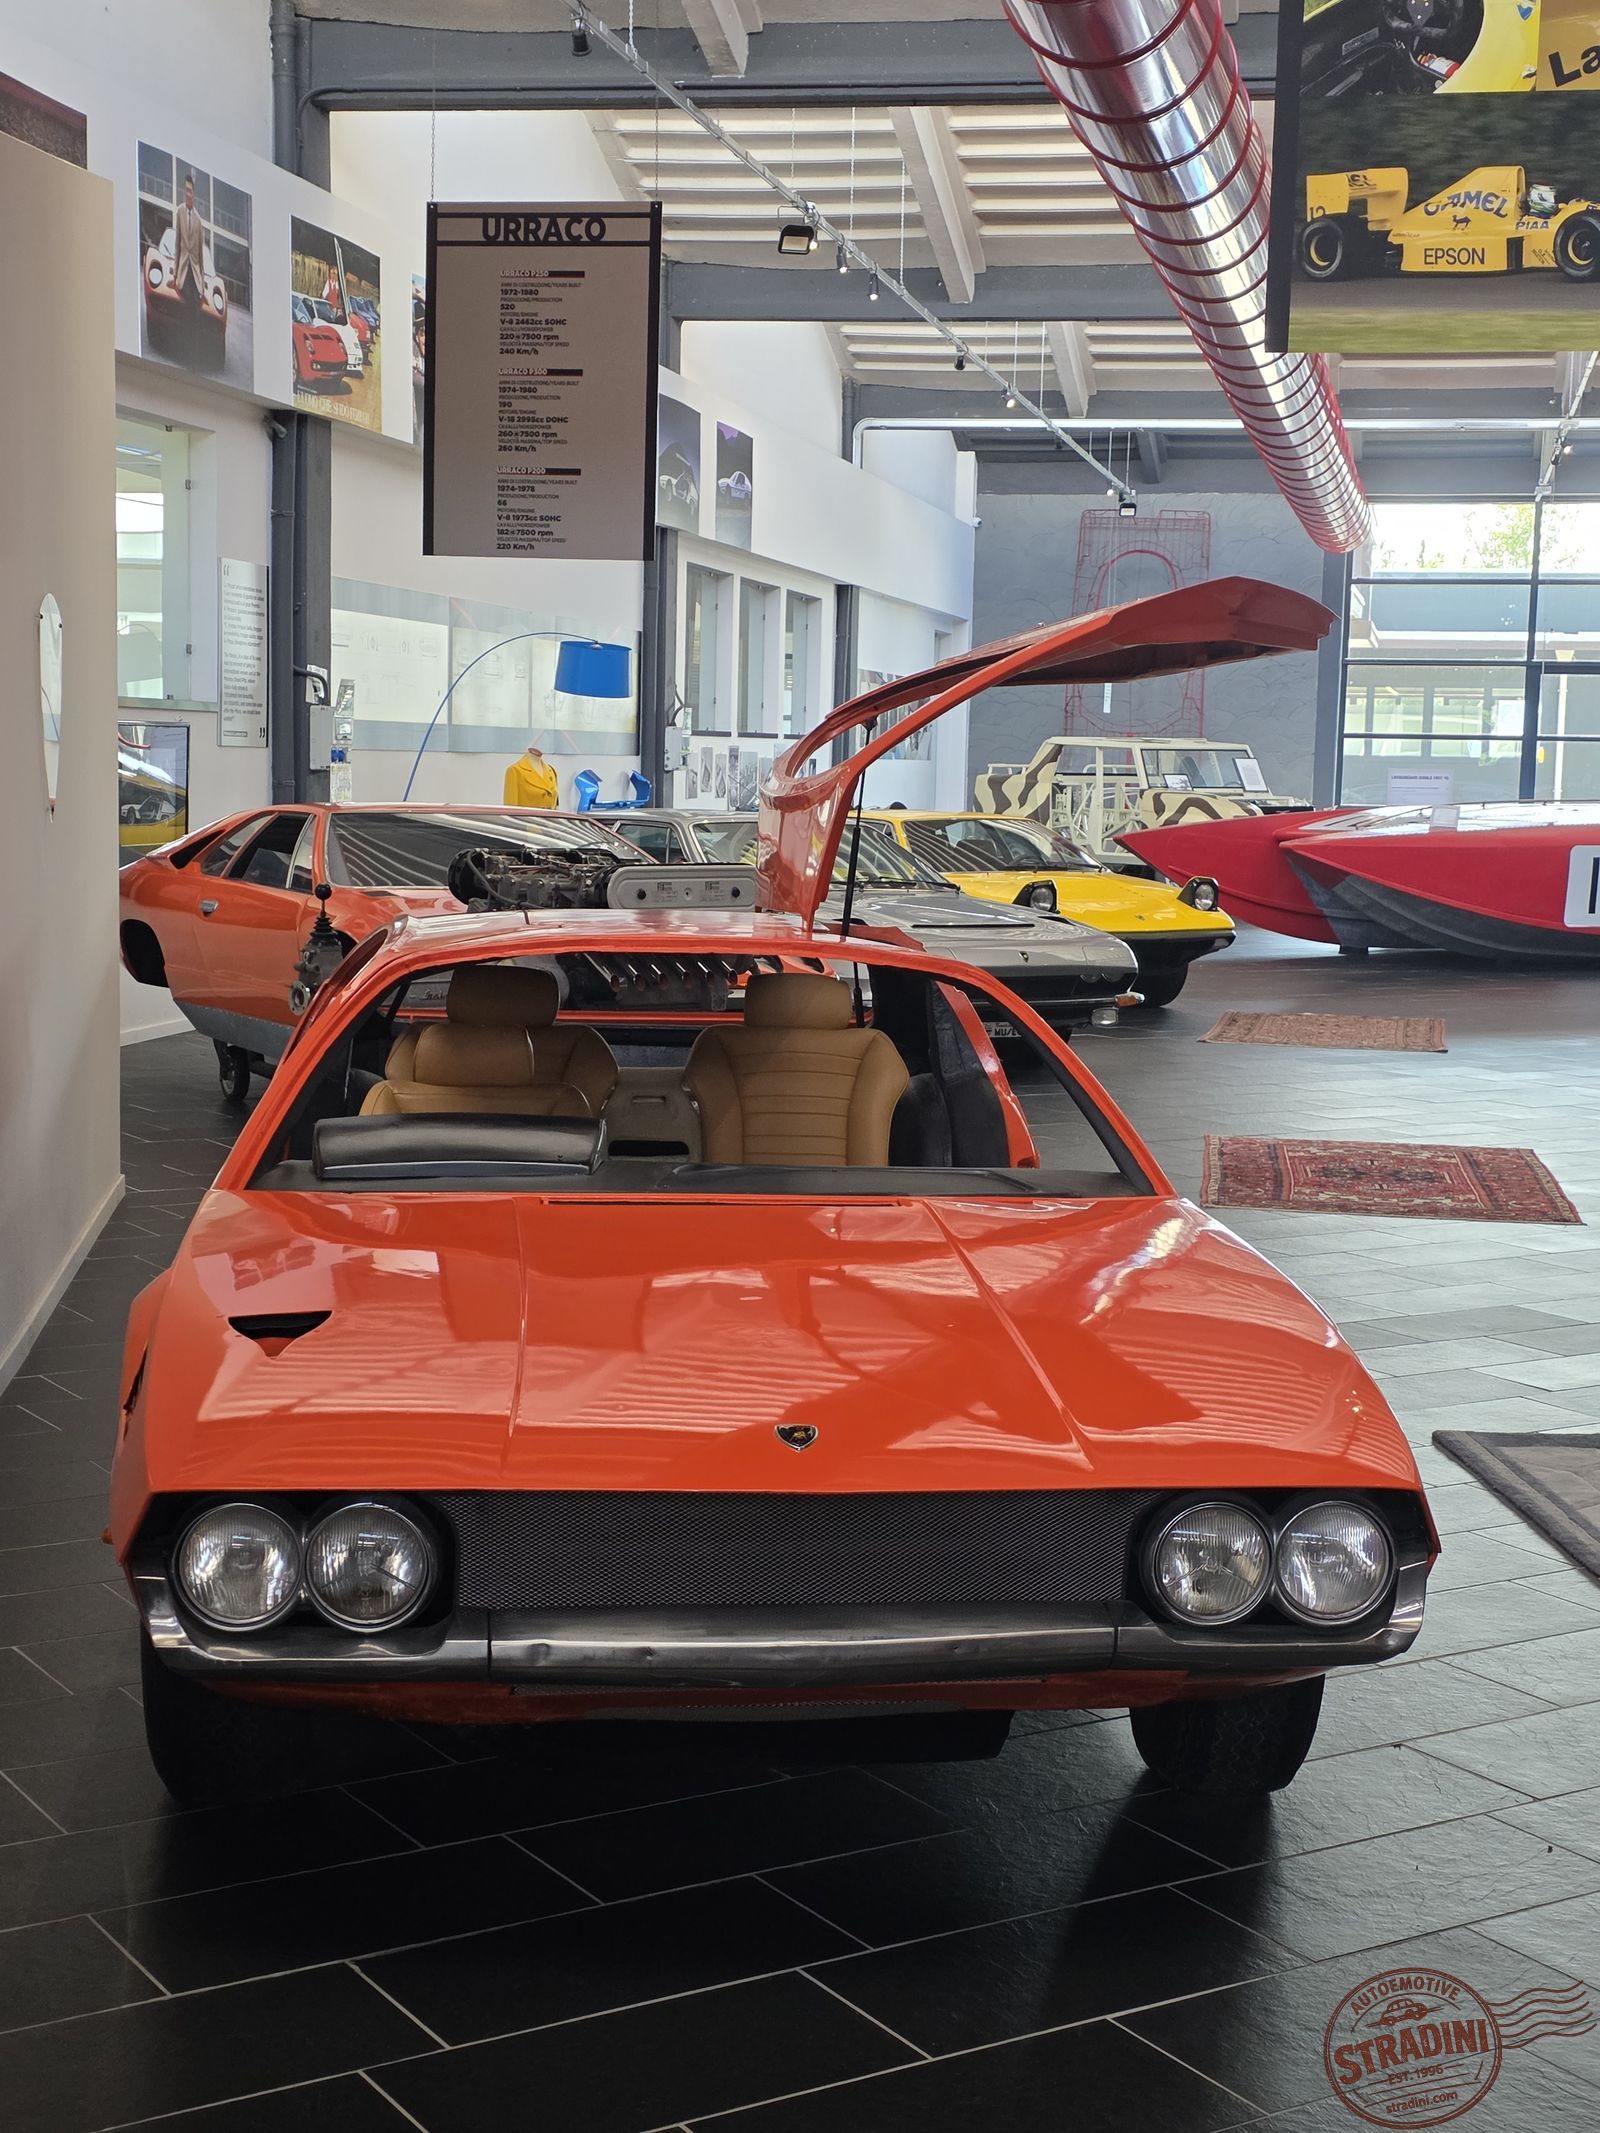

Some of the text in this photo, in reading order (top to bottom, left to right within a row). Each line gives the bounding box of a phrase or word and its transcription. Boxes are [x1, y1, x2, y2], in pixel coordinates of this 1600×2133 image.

[1423, 189, 1509, 219] CAMEL
[481, 215, 607, 244] URRACO
[1515, 220, 1550, 231] PIAA
[1424, 247, 1485, 266] EPSON
[516, 348, 539, 356] Km/h
[498, 368, 528, 376] URRACO
[514, 445, 536, 453] Km/h
[513, 543, 535, 551] Km/h
